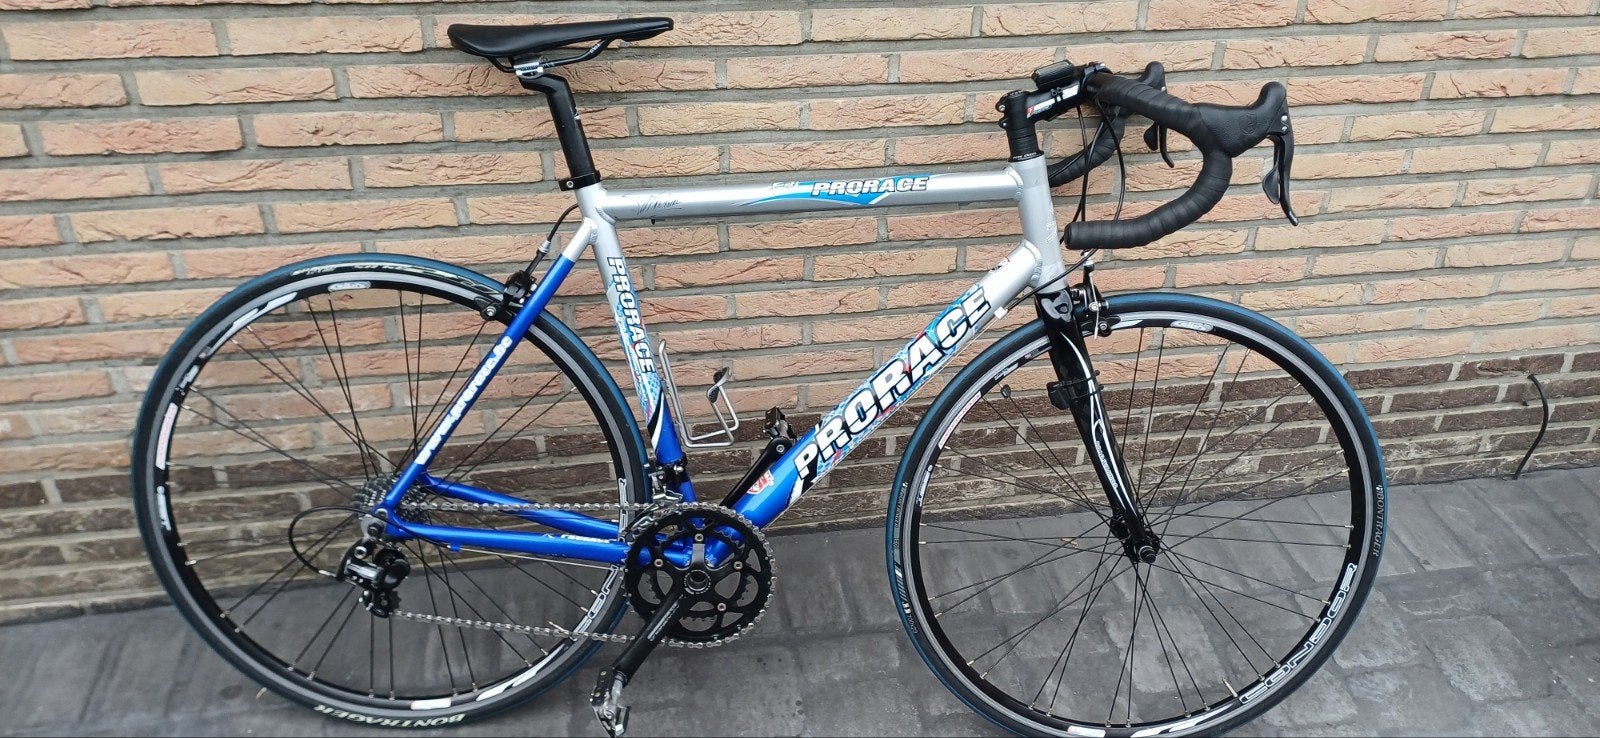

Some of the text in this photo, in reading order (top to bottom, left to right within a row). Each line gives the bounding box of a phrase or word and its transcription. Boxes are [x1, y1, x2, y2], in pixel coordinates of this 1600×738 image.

[811, 176, 929, 197] PRORACE
[607, 256, 656, 374] PRORACE
[793, 286, 991, 481] PRORACE
[1372, 491, 1385, 557] BONTRAGER
[1239, 563, 1357, 704] CONDOR
[313, 704, 466, 728] BONTRAGER
